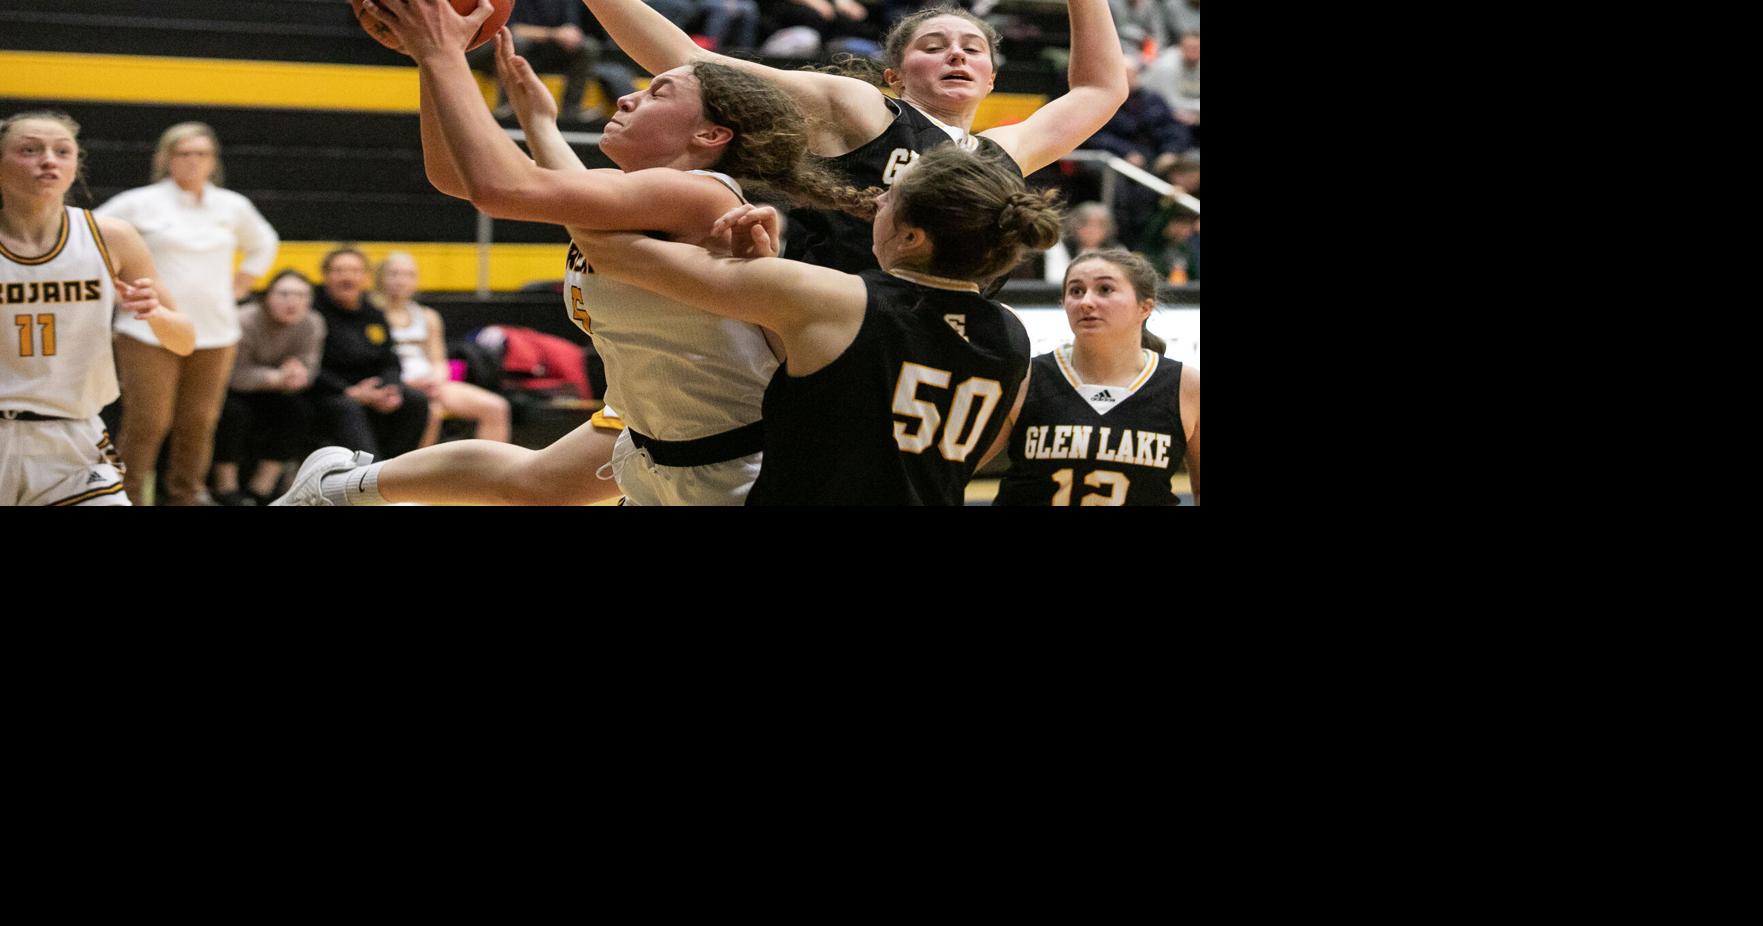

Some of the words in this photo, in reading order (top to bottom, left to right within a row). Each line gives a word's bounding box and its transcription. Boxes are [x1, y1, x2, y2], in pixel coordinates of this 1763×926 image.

[0, 280, 101, 304] OJANS
[15, 313, 56, 357] 11
[892, 361, 1003, 462] 50
[1024, 425, 1093, 459] GLEN
[1096, 427, 1172, 469] LAKE
